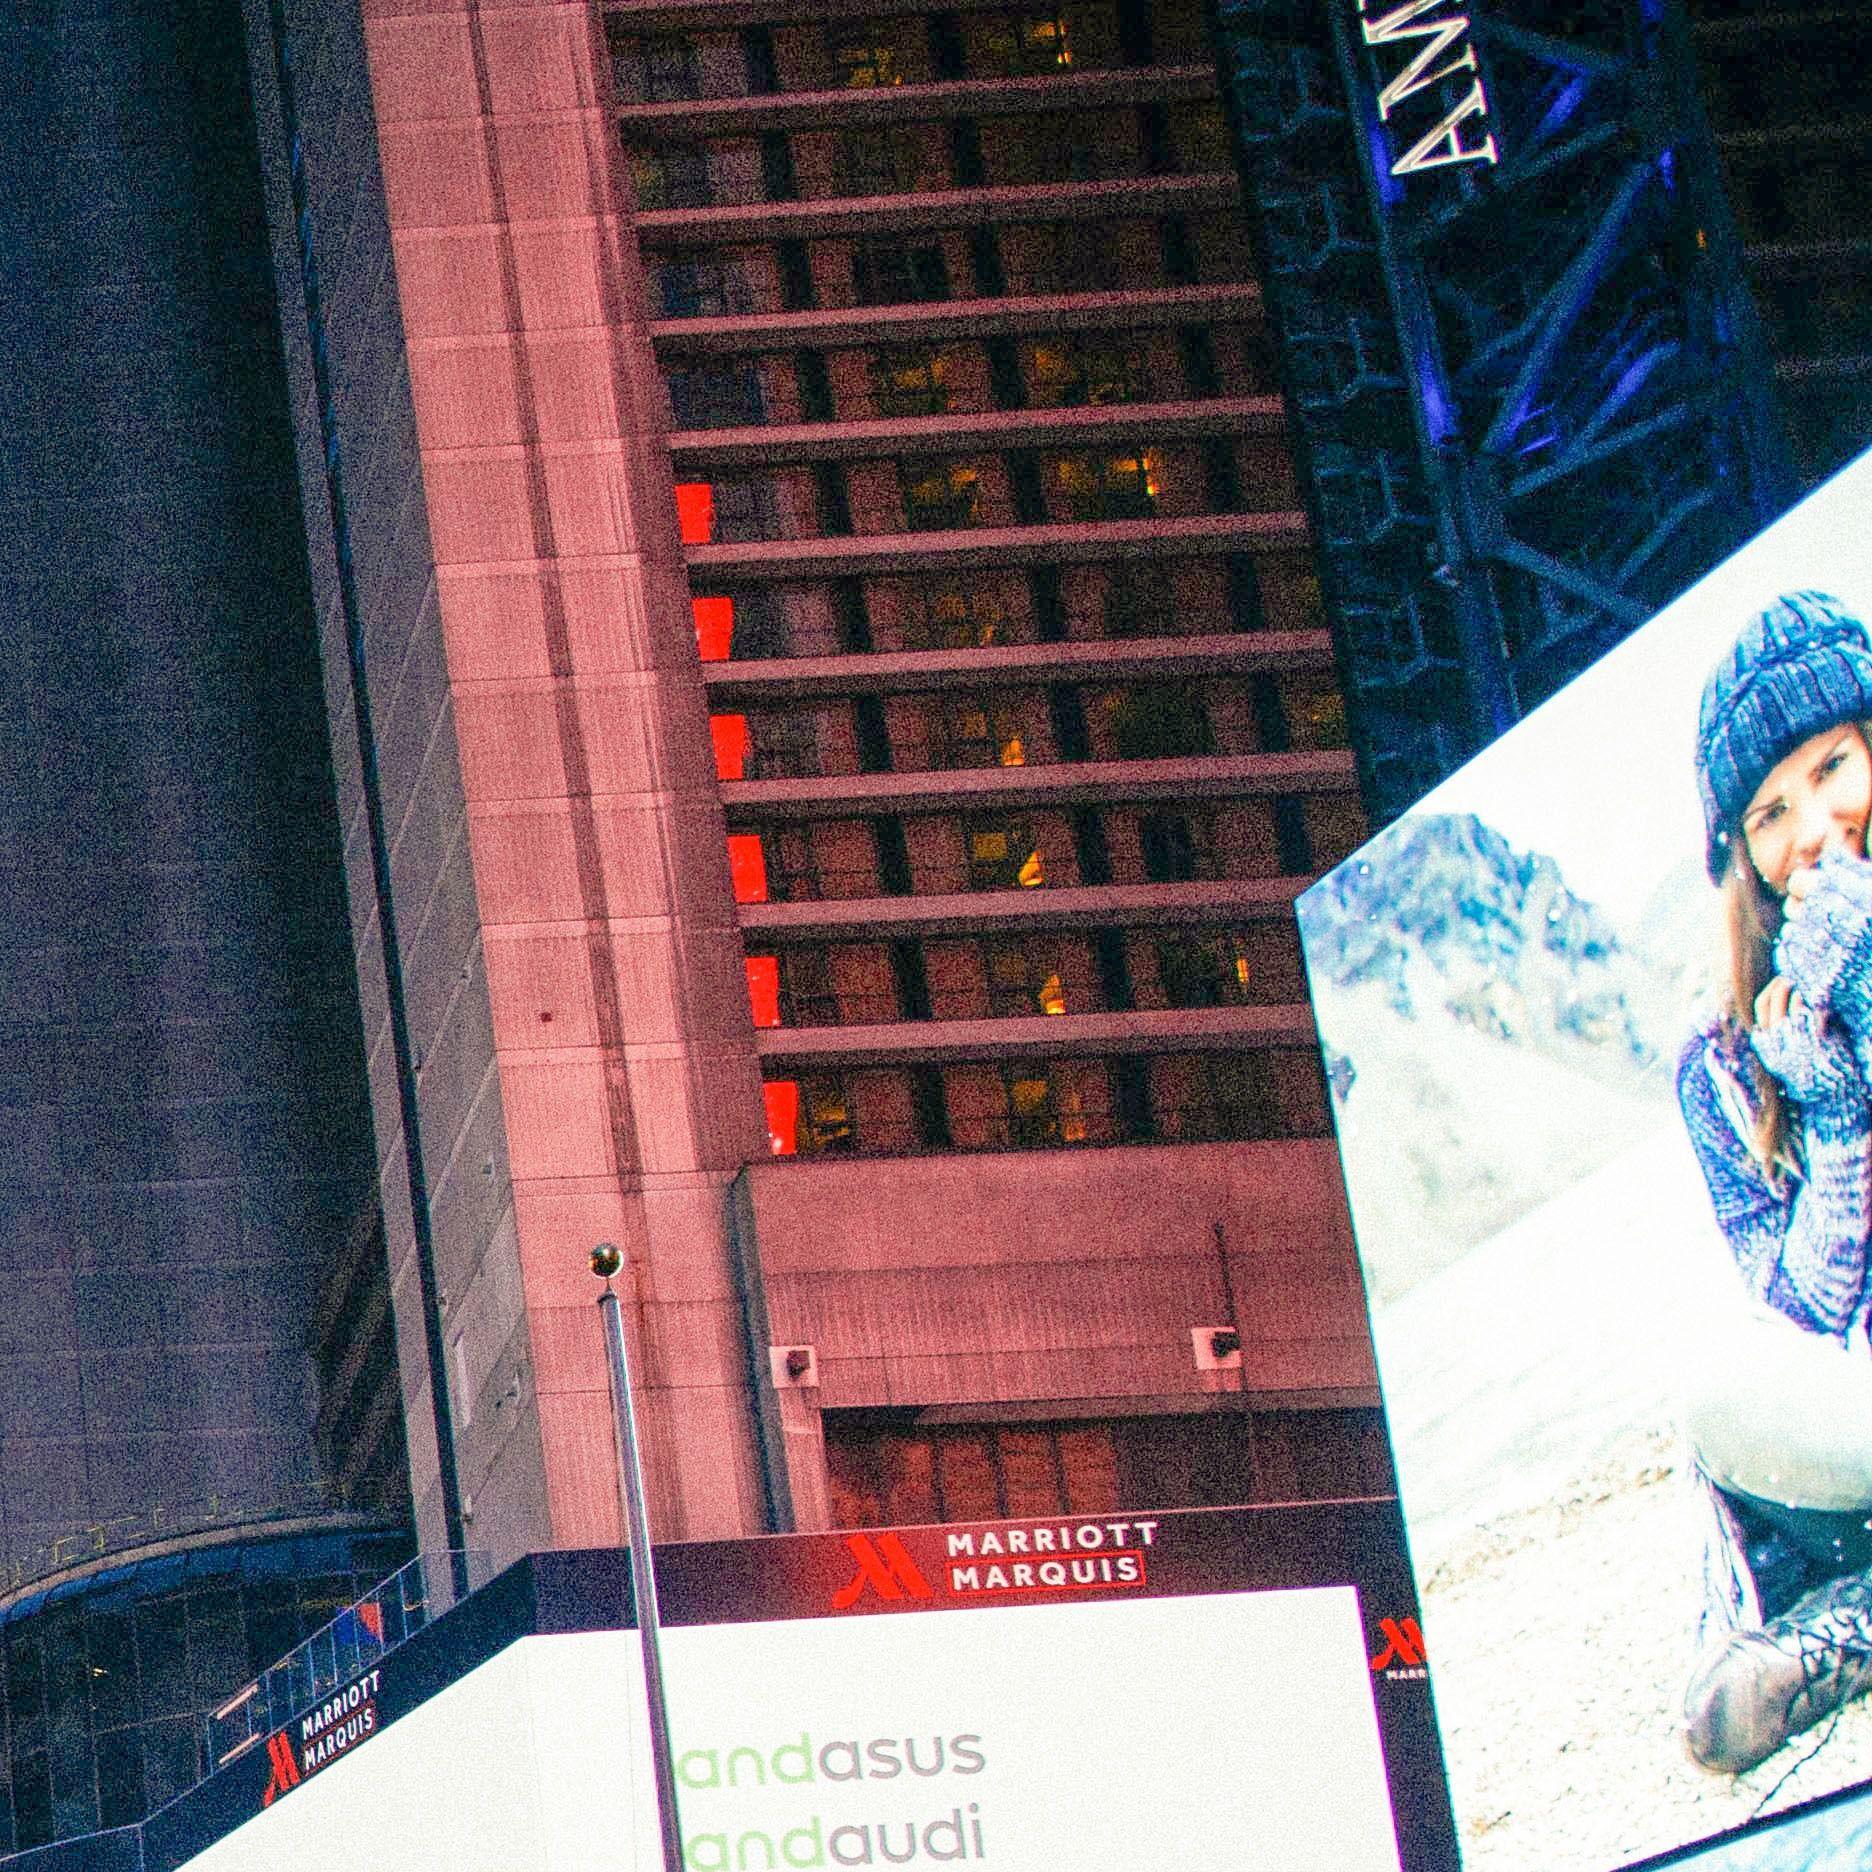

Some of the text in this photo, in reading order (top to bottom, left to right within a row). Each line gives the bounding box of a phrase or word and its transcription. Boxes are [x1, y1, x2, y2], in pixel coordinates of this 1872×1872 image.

[946, 1520, 1158, 1557] MARRIOTT
[951, 1554, 1142, 1590] MARQUIS
[301, 1668, 381, 1742] MARRIOTT
[303, 1705, 376, 1772] MARQUIS
[675, 1731, 988, 1790] andasus
